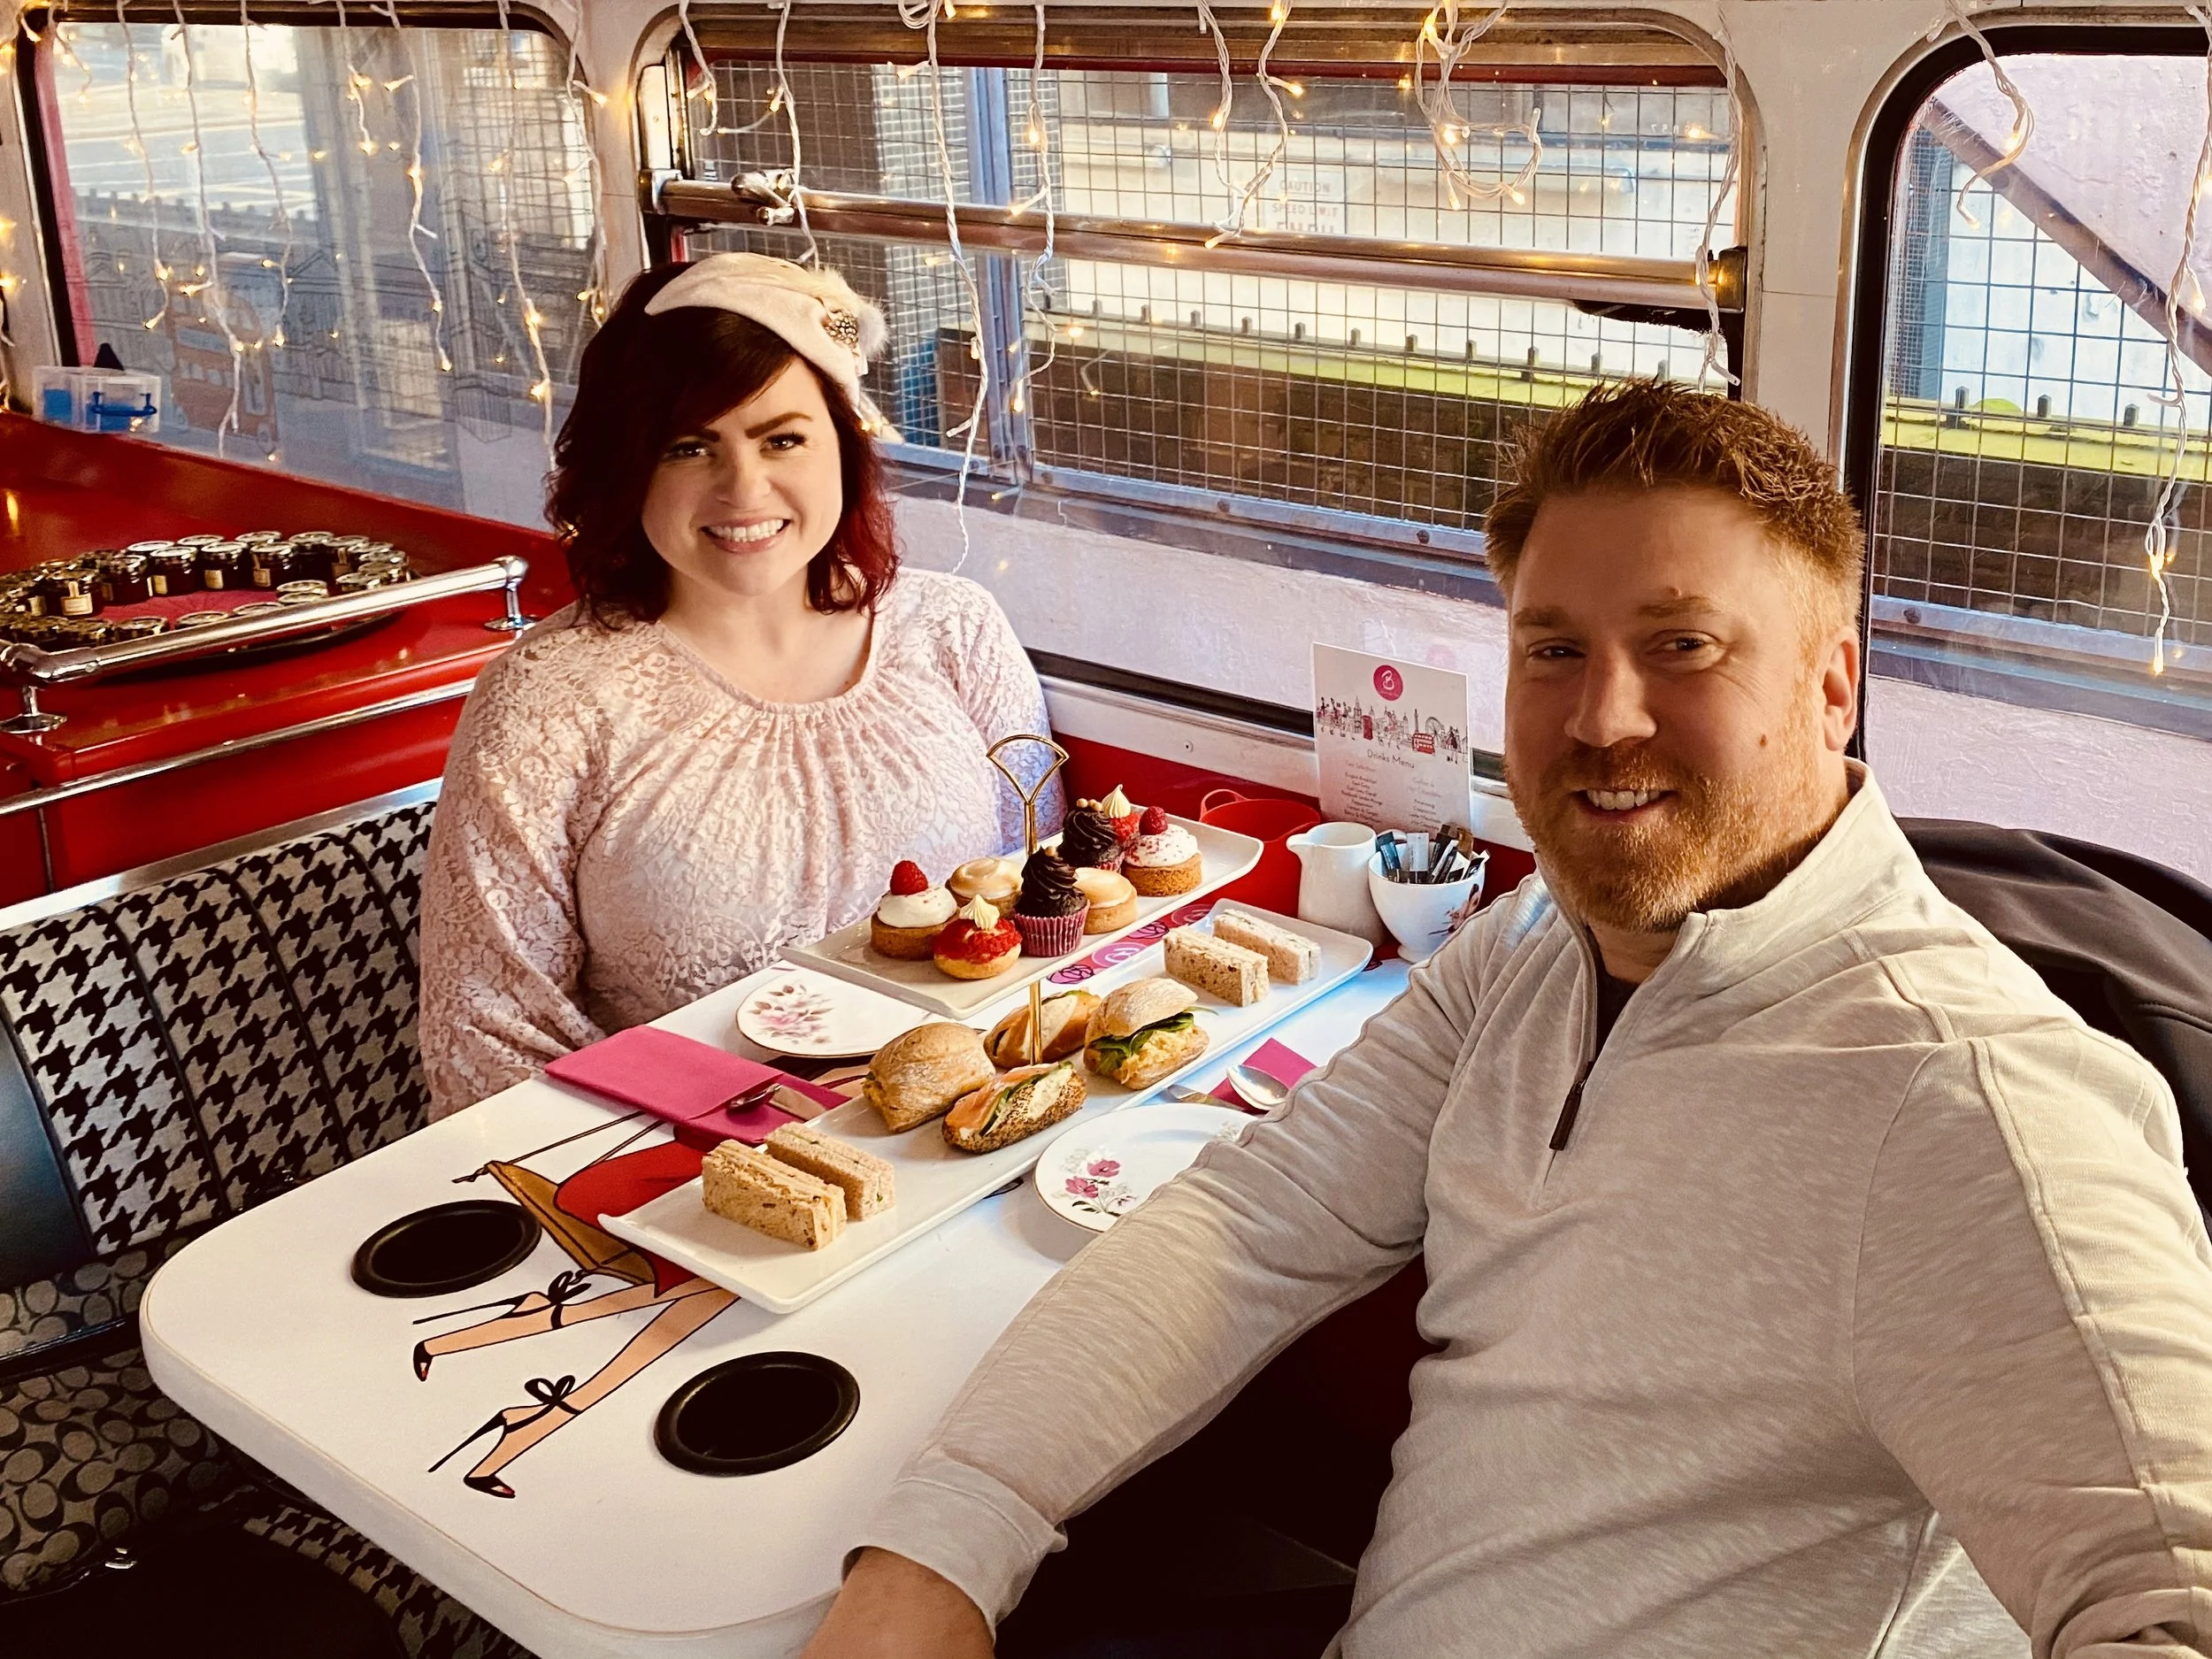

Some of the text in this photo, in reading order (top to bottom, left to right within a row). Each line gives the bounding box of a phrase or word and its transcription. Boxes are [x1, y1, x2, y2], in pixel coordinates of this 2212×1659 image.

[1279, 180, 1331, 192] CAUTION
[1272, 203, 1305, 214] SPEED
[1367, 749, 1390, 763] Drinks
[1392, 755, 1415, 769] Menu
